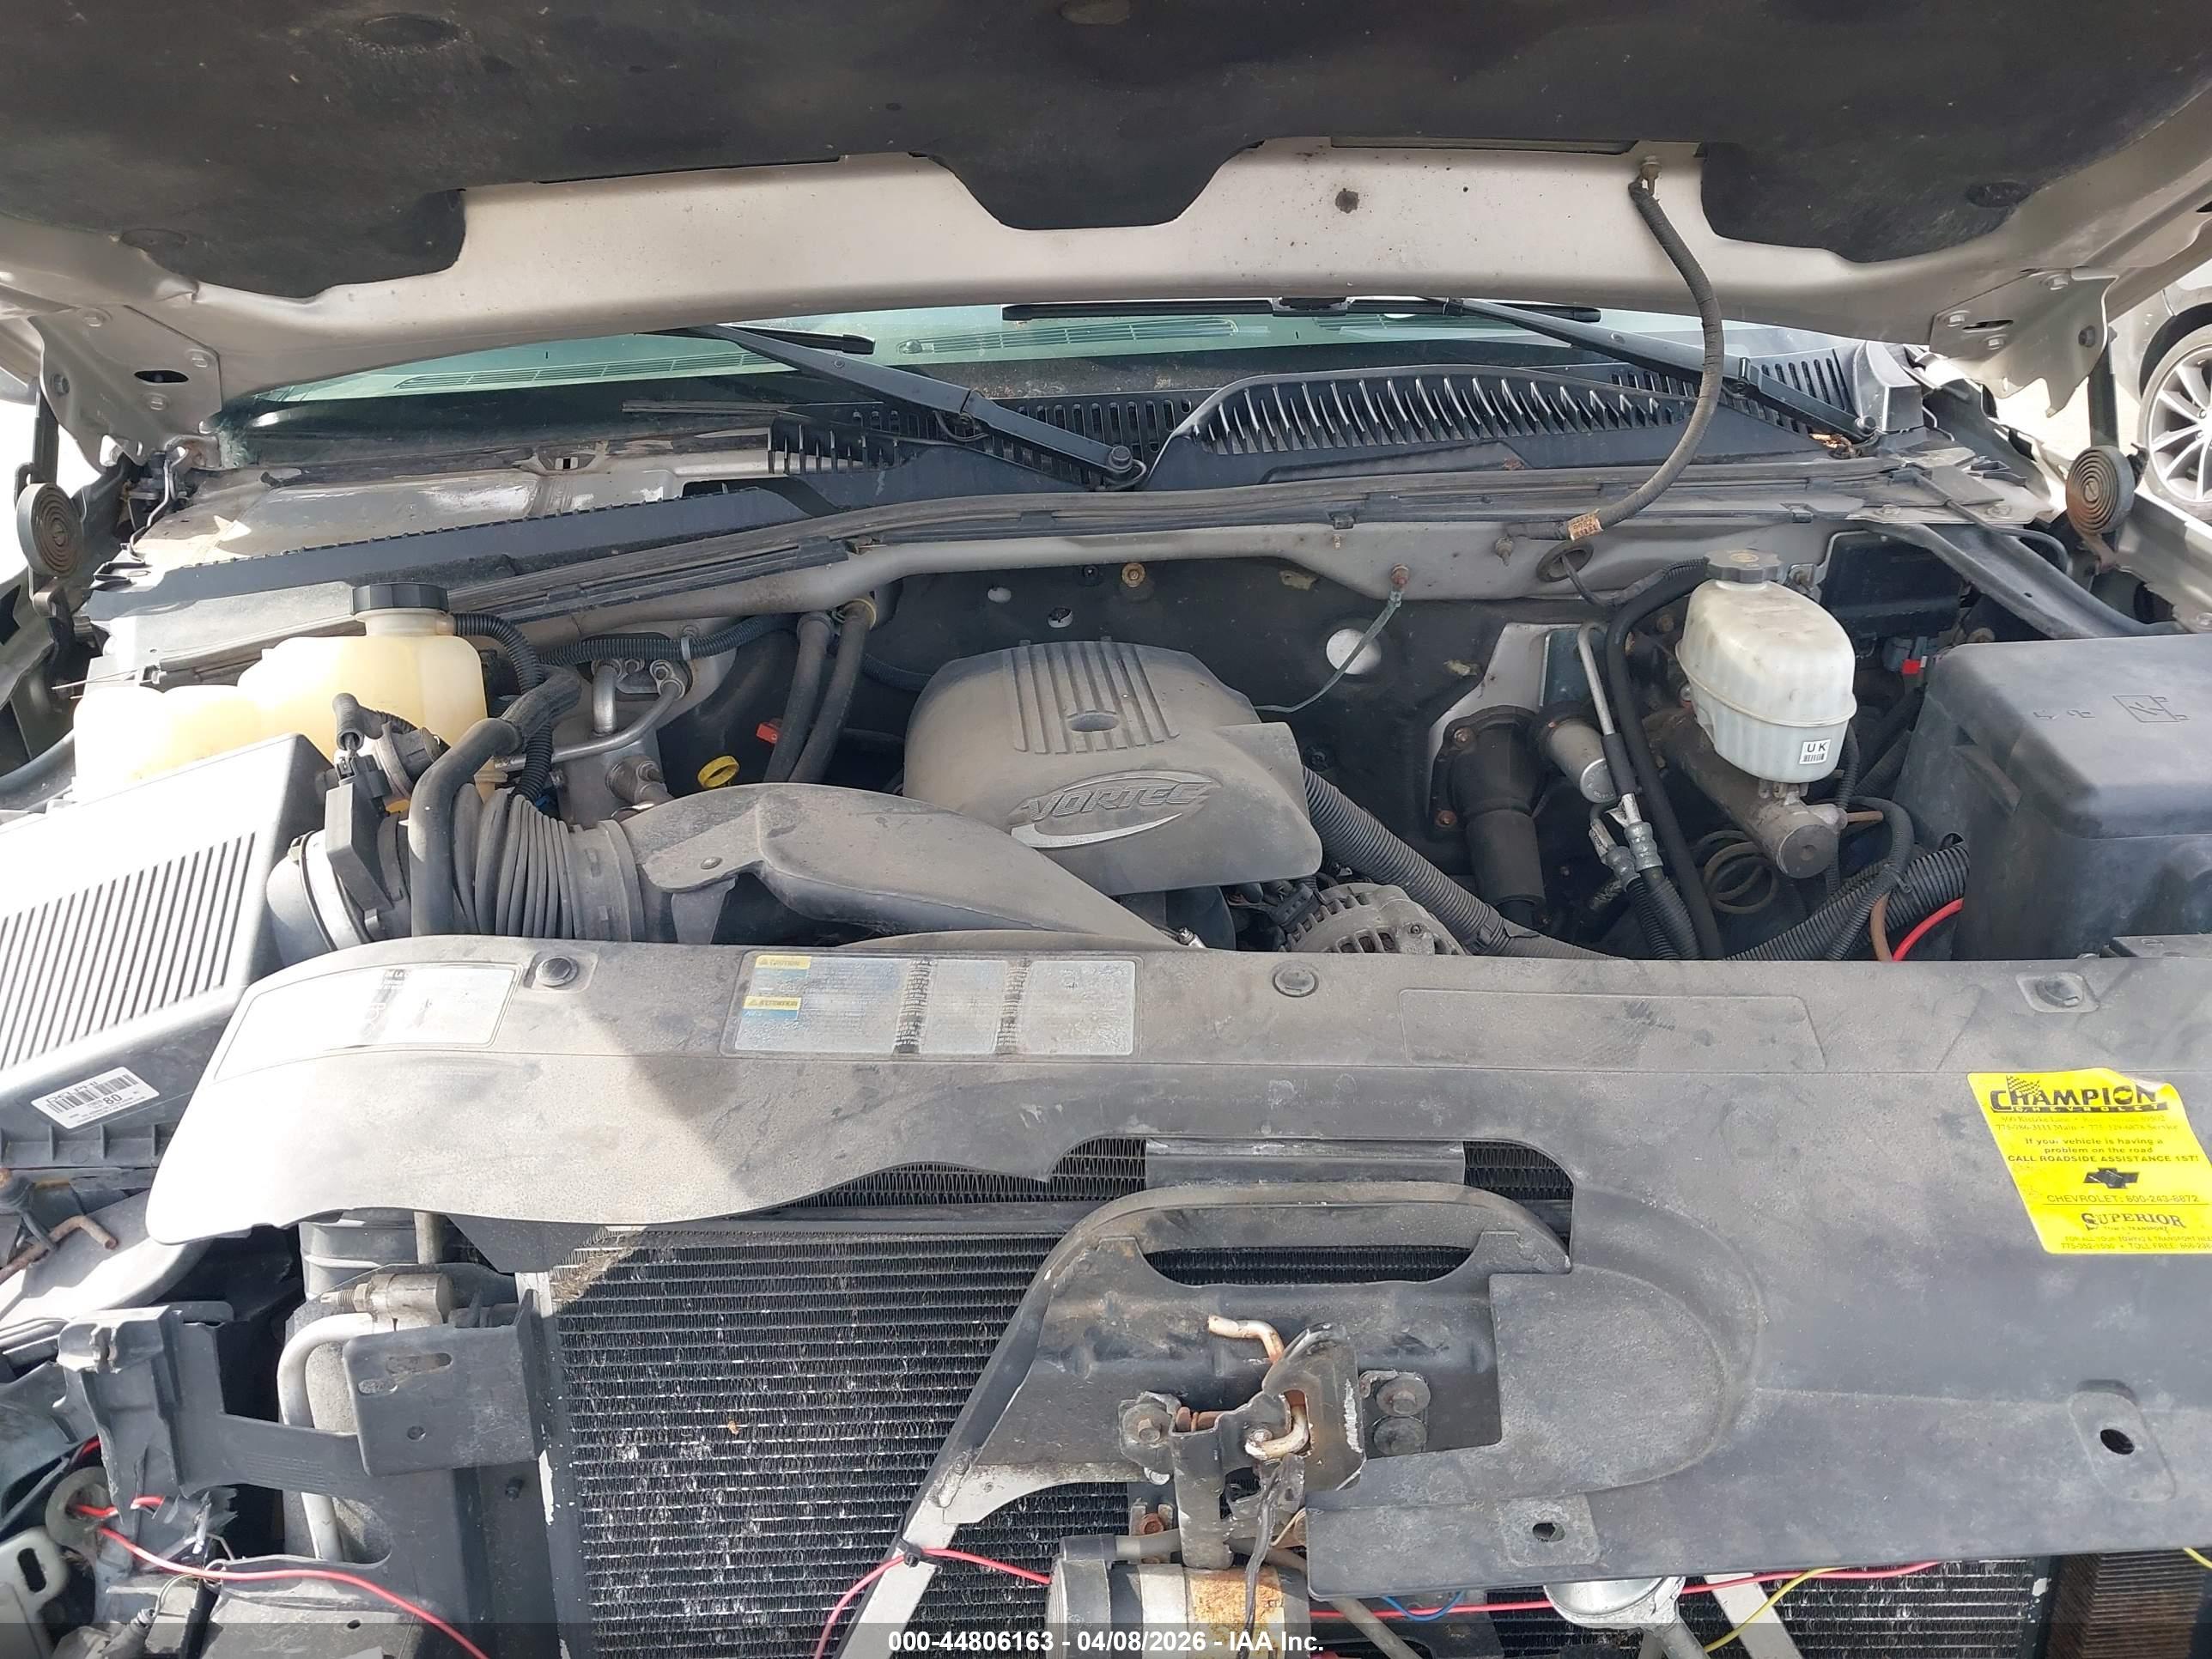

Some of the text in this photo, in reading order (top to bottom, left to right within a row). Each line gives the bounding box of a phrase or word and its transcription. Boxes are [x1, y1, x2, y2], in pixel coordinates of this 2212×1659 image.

[1022, 783, 1209, 822] VORTEC
[103, 1094, 122, 1104] 80
[1990, 1084, 2157, 1110] CHAMPION
[2081, 1212, 2187, 1231] SUPERIOR
